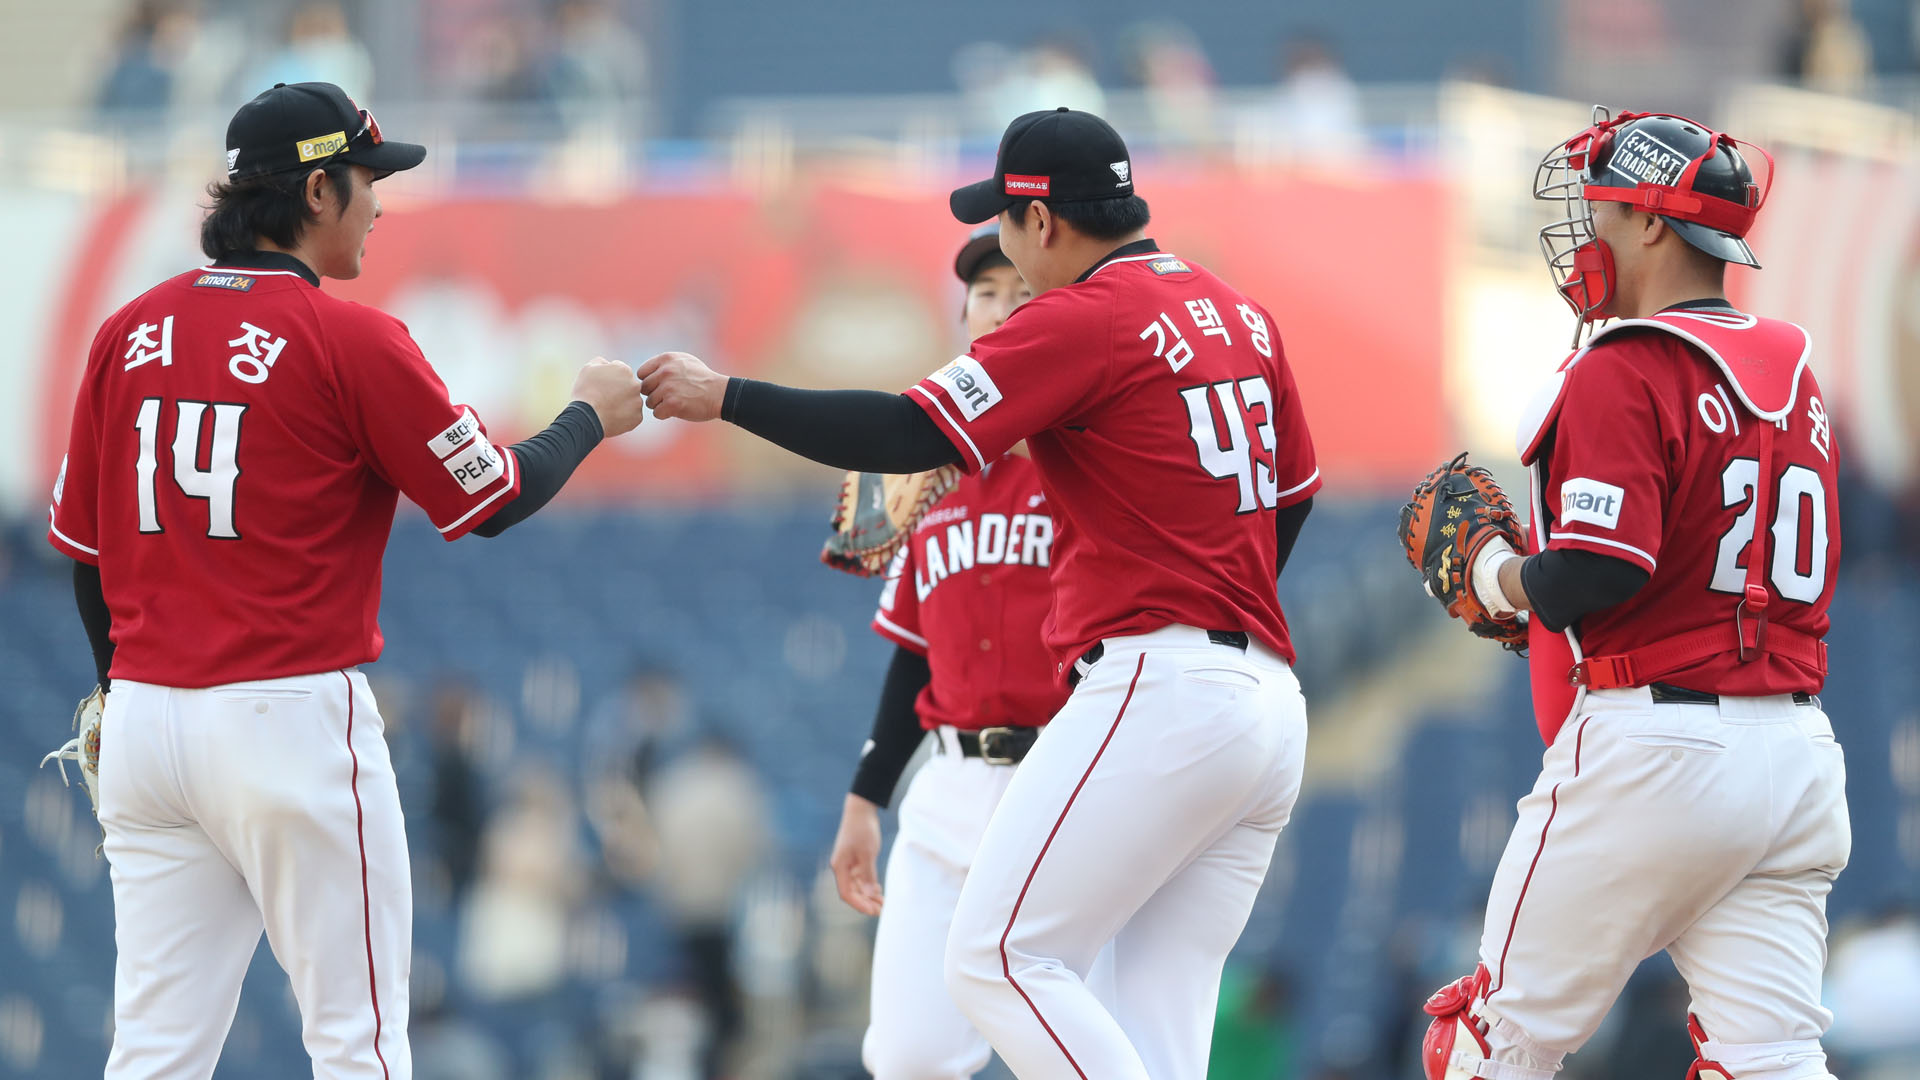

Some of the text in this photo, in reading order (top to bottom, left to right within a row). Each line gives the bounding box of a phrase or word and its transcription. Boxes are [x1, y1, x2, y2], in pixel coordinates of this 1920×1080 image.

[302, 137, 344, 157] emart
[1616, 148, 1670, 185] TRADERS
[197, 274, 250, 289] emart24
[124, 315, 288, 384] 최 정
[134, 397, 249, 540] 14
[1178, 374, 1277, 515] 43
[915, 513, 1054, 603] LANDER
[1706, 455, 1829, 606] 20
